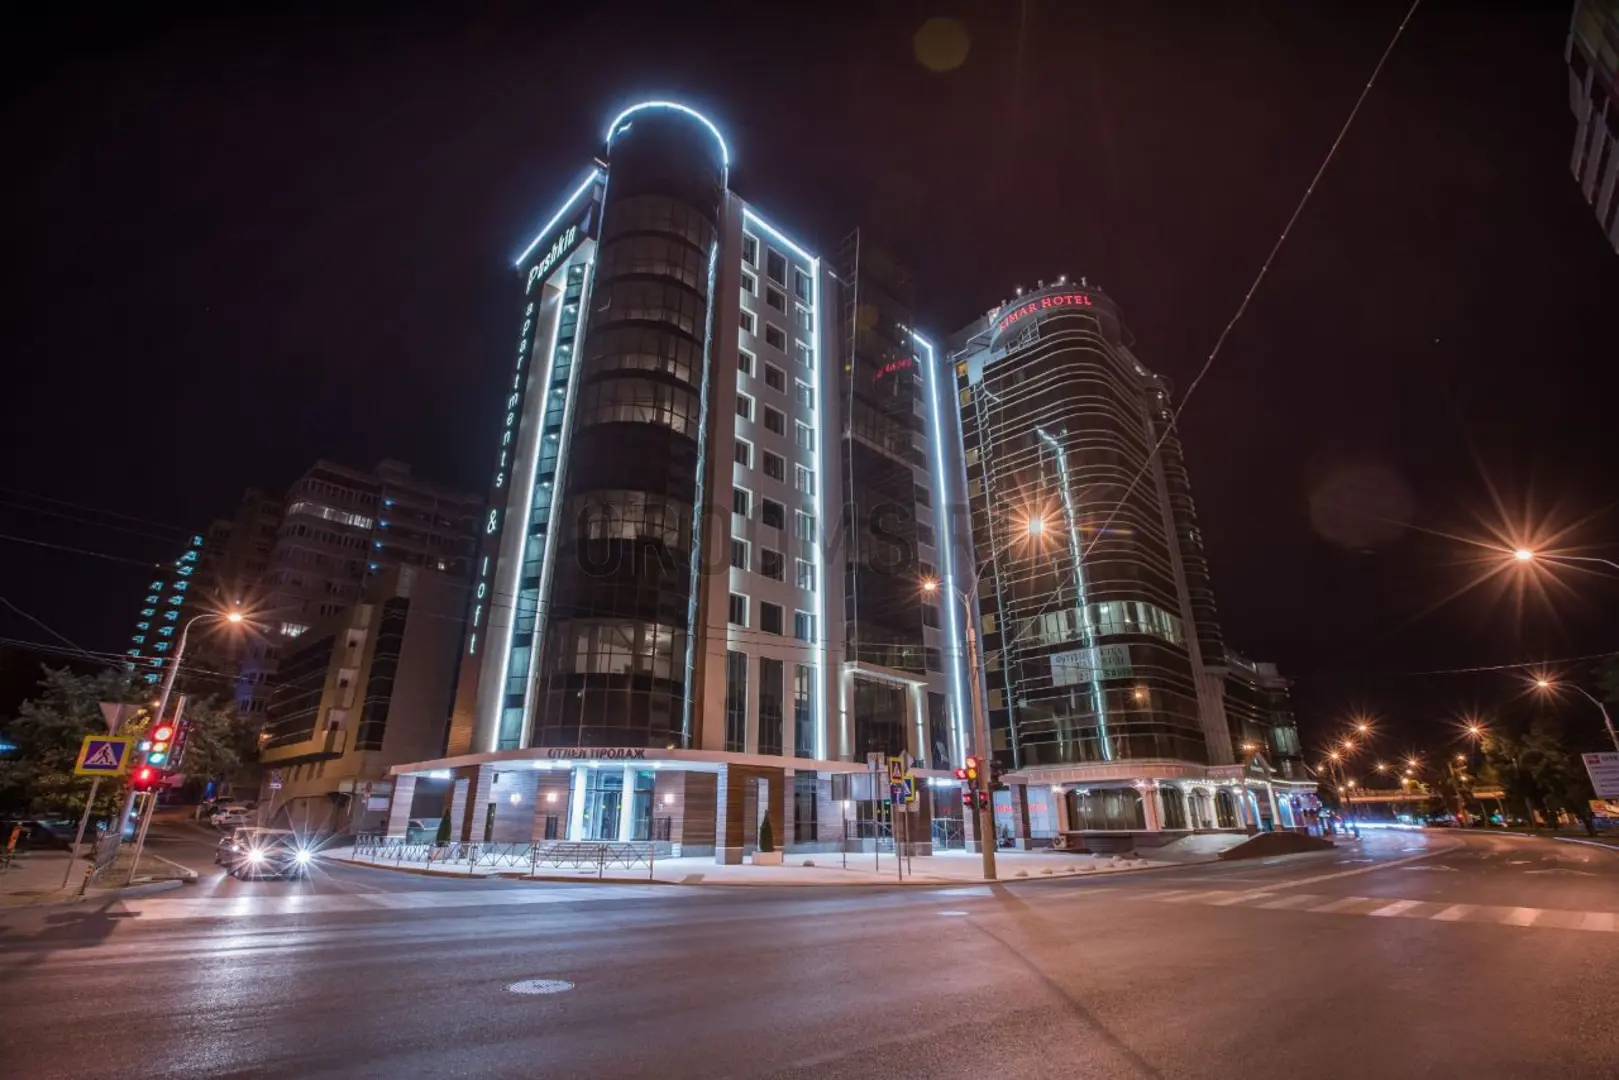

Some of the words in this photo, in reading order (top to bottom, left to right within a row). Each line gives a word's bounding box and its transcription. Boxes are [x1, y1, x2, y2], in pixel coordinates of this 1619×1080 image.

[526, 225, 577, 296] Pushkin
[1042, 295, 1091, 308] HOTEL
[469, 556, 488, 654] loft
[547, 748, 587, 759] ОТДЕЛ
[590, 748, 645, 759] ПРОДАЖ
